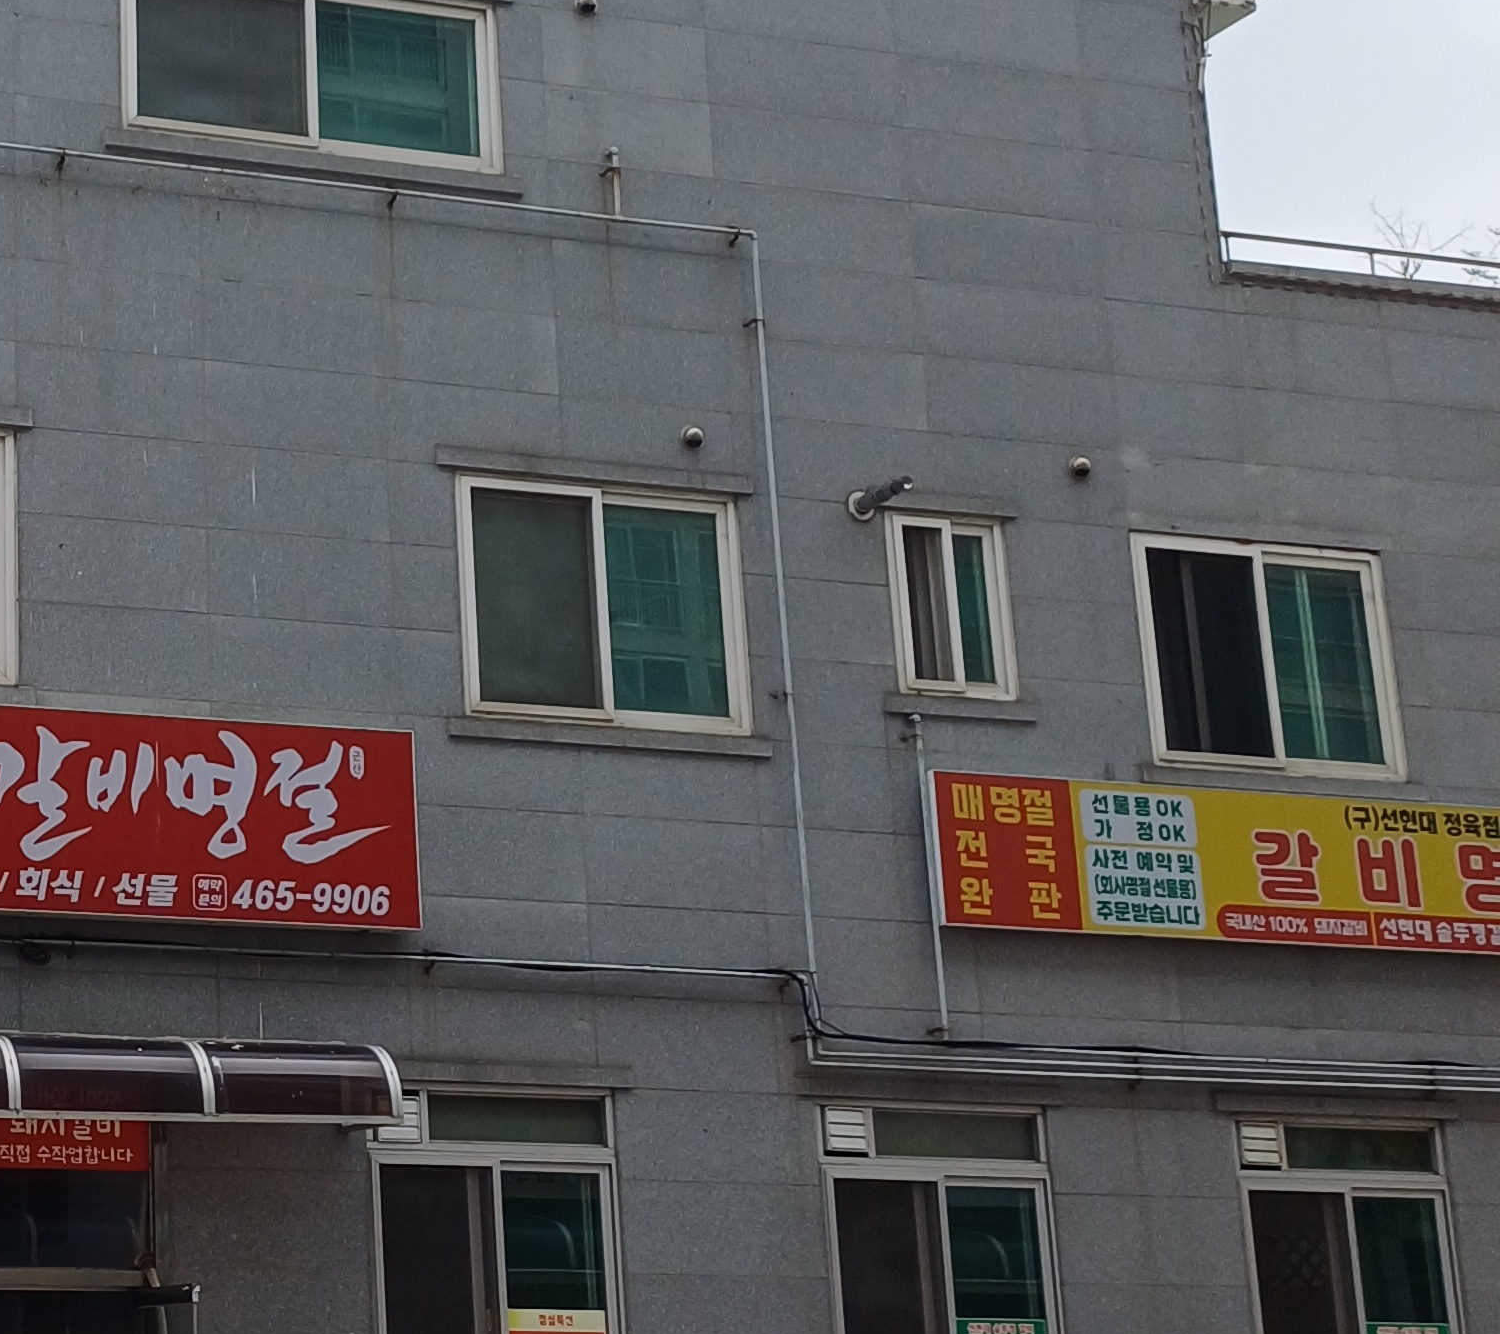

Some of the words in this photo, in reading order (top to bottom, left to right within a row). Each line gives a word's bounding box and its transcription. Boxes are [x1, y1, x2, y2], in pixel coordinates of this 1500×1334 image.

[1092, 849, 1128, 870] 사전
[1137, 851, 1172, 872] 예약
[15, 867, 84, 903] 회식
[112, 871, 178, 908] 선물
[232, 879, 390, 916] 465-9906
[1096, 901, 1200, 925] 주문받습니다
[1268, 916, 1308, 933] 100%
[0, 1144, 30, 1164] 직접
[36, 1144, 133, 1165] 수작업합니다
